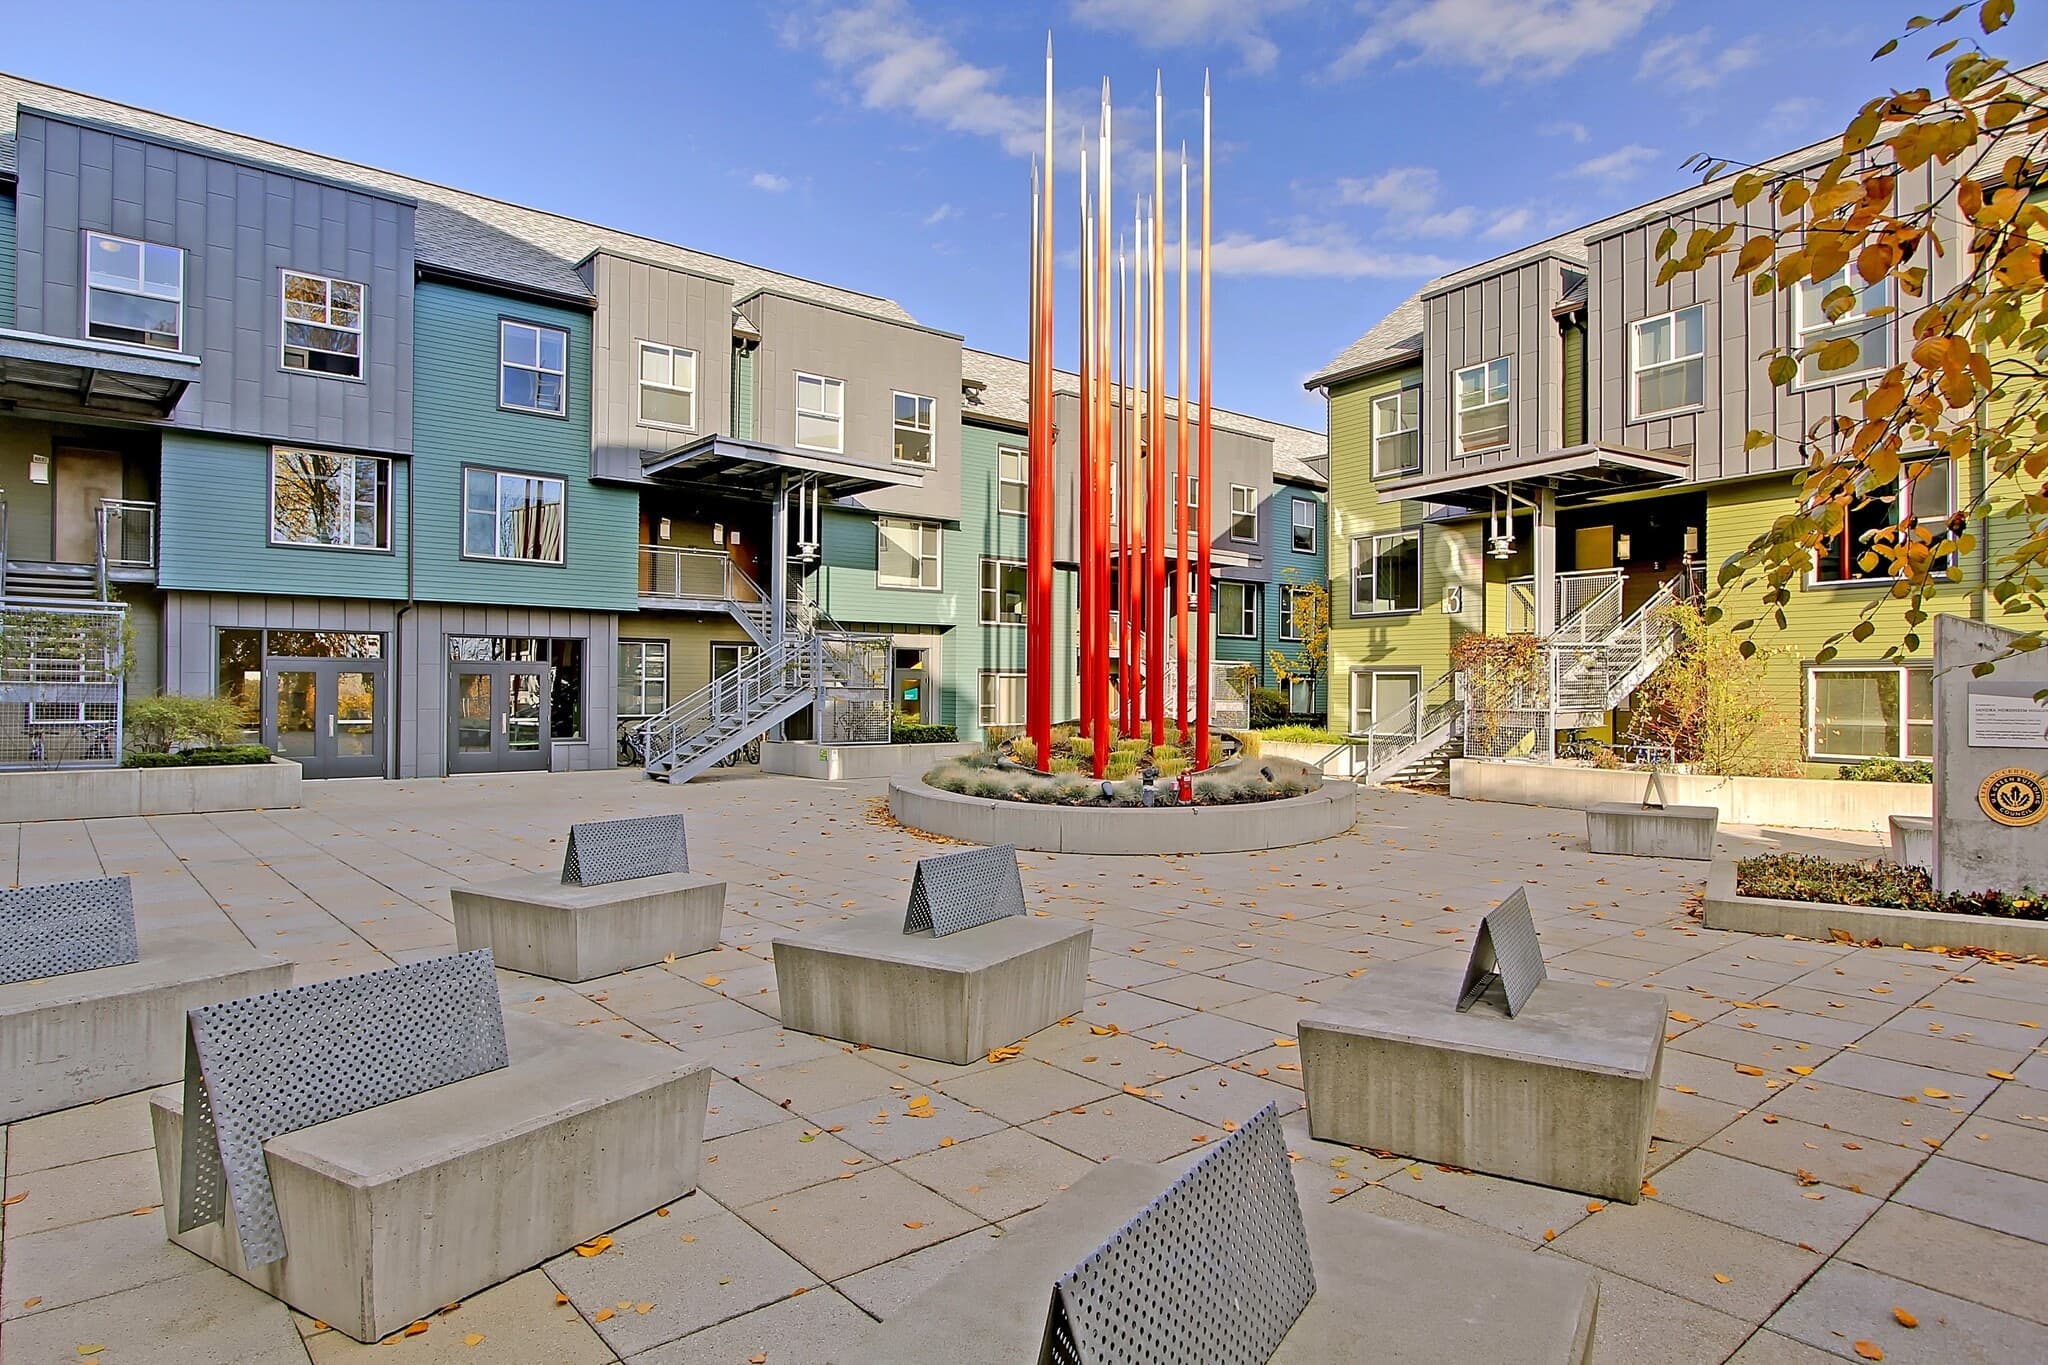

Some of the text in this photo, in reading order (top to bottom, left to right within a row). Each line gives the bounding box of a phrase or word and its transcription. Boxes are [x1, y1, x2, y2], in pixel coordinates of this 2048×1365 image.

[1447, 586, 1461, 613] 3
[1992, 777, 2015, 792] GREEN
[2016, 777, 2041, 805] BUILDING
[1999, 807, 2033, 817] COUNCIL
